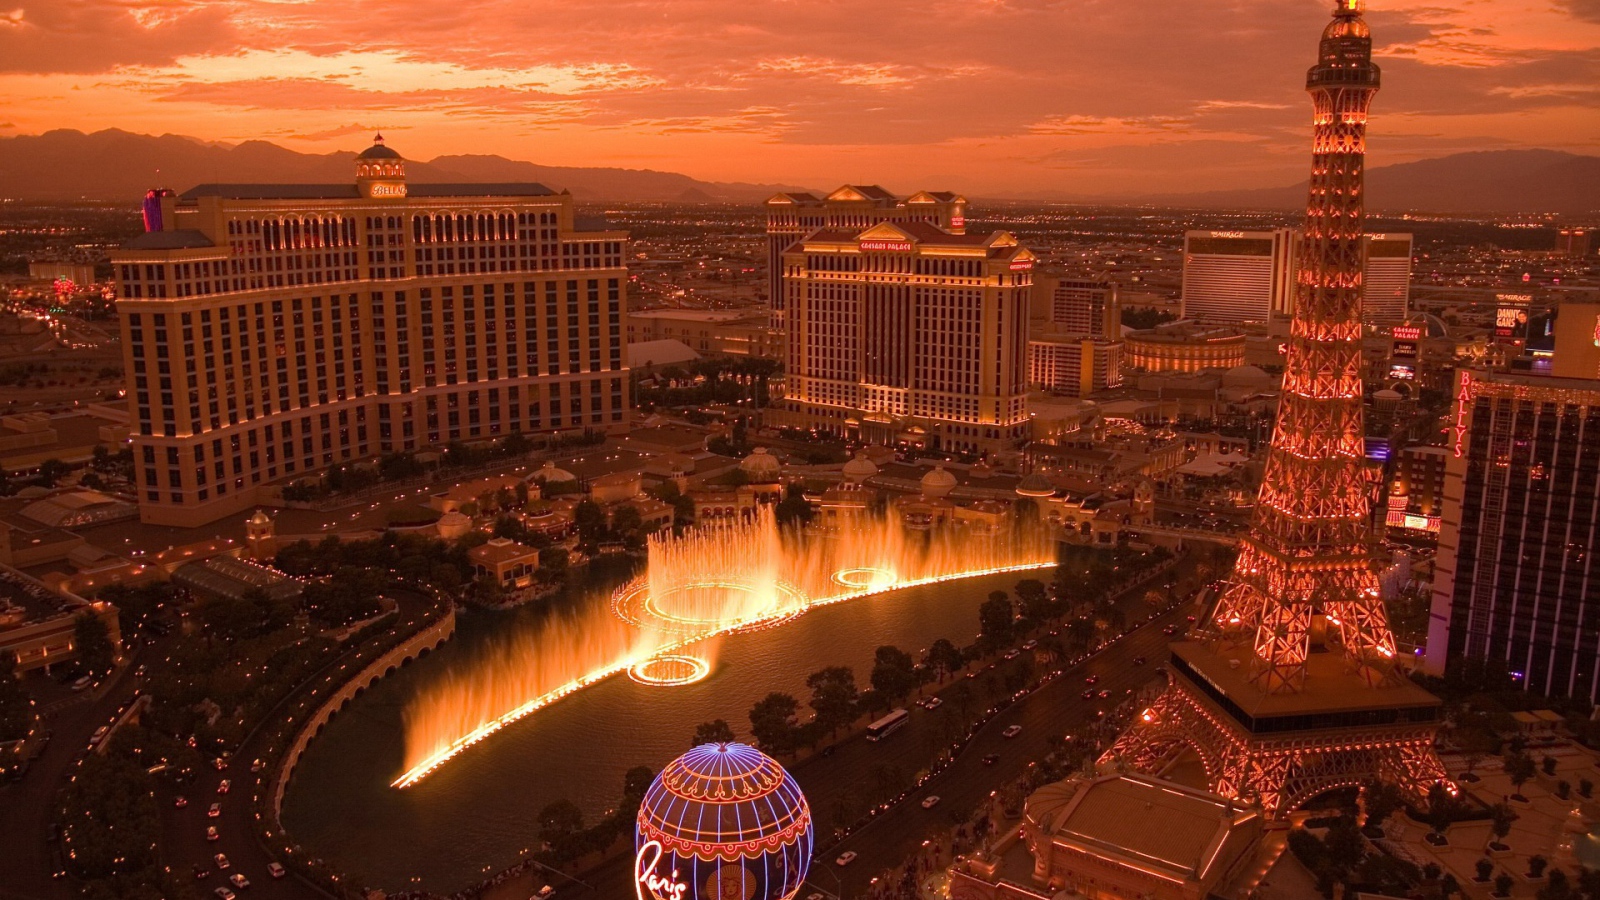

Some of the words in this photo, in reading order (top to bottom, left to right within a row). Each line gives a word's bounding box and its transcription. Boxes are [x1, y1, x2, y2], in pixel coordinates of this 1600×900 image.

[1497, 308, 1521, 319] DANNY
[1496, 317, 1516, 327] GANS
[635, 840, 687, 900] Paris
